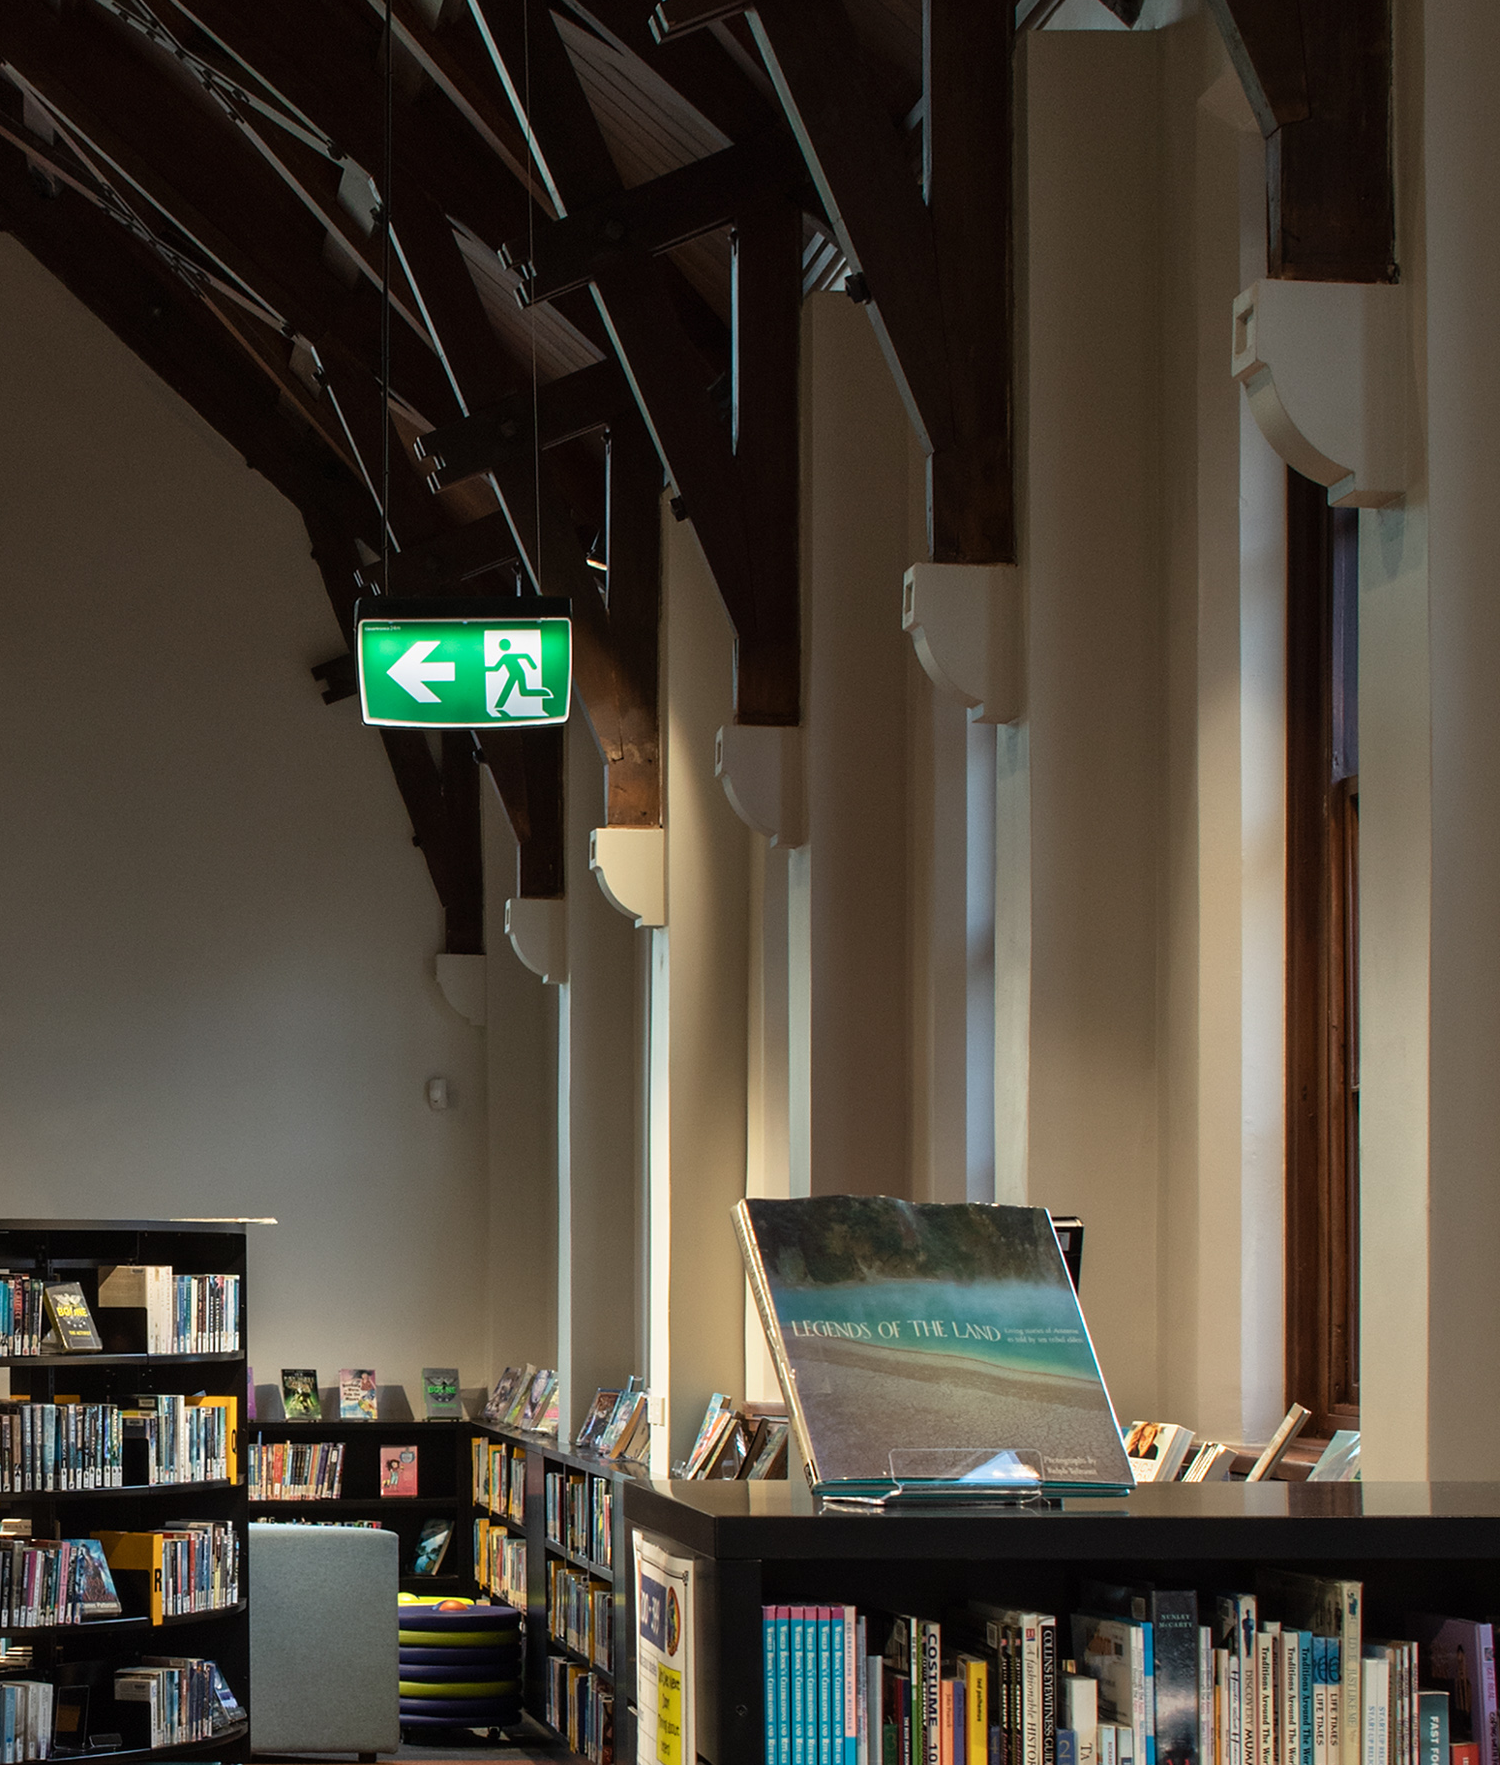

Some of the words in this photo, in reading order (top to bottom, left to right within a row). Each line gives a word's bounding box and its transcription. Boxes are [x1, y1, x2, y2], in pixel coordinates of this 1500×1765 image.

[791, 1320, 871, 1339] LEGENDS
[878, 1321, 901, 1339] OF
[907, 1320, 948, 1337] THE
[952, 1321, 1001, 1342] LAND
[154, 1568, 162, 1593] R
[1027, 1645, 1036, 1655] A
[1043, 1630, 1053, 1672] COLLINS
[1261, 1647, 1270, 1690] Traditions
[928, 1633, 937, 1727] COSTUME
[1025, 1657, 1037, 1719] fashionable
[1244, 1670, 1254, 1726] DISCOVERY
[1043, 1673, 1053, 1735] EYEWITNESS
[1262, 1693, 1270, 1725] Around
[1429, 1716, 1439, 1744] FAST
